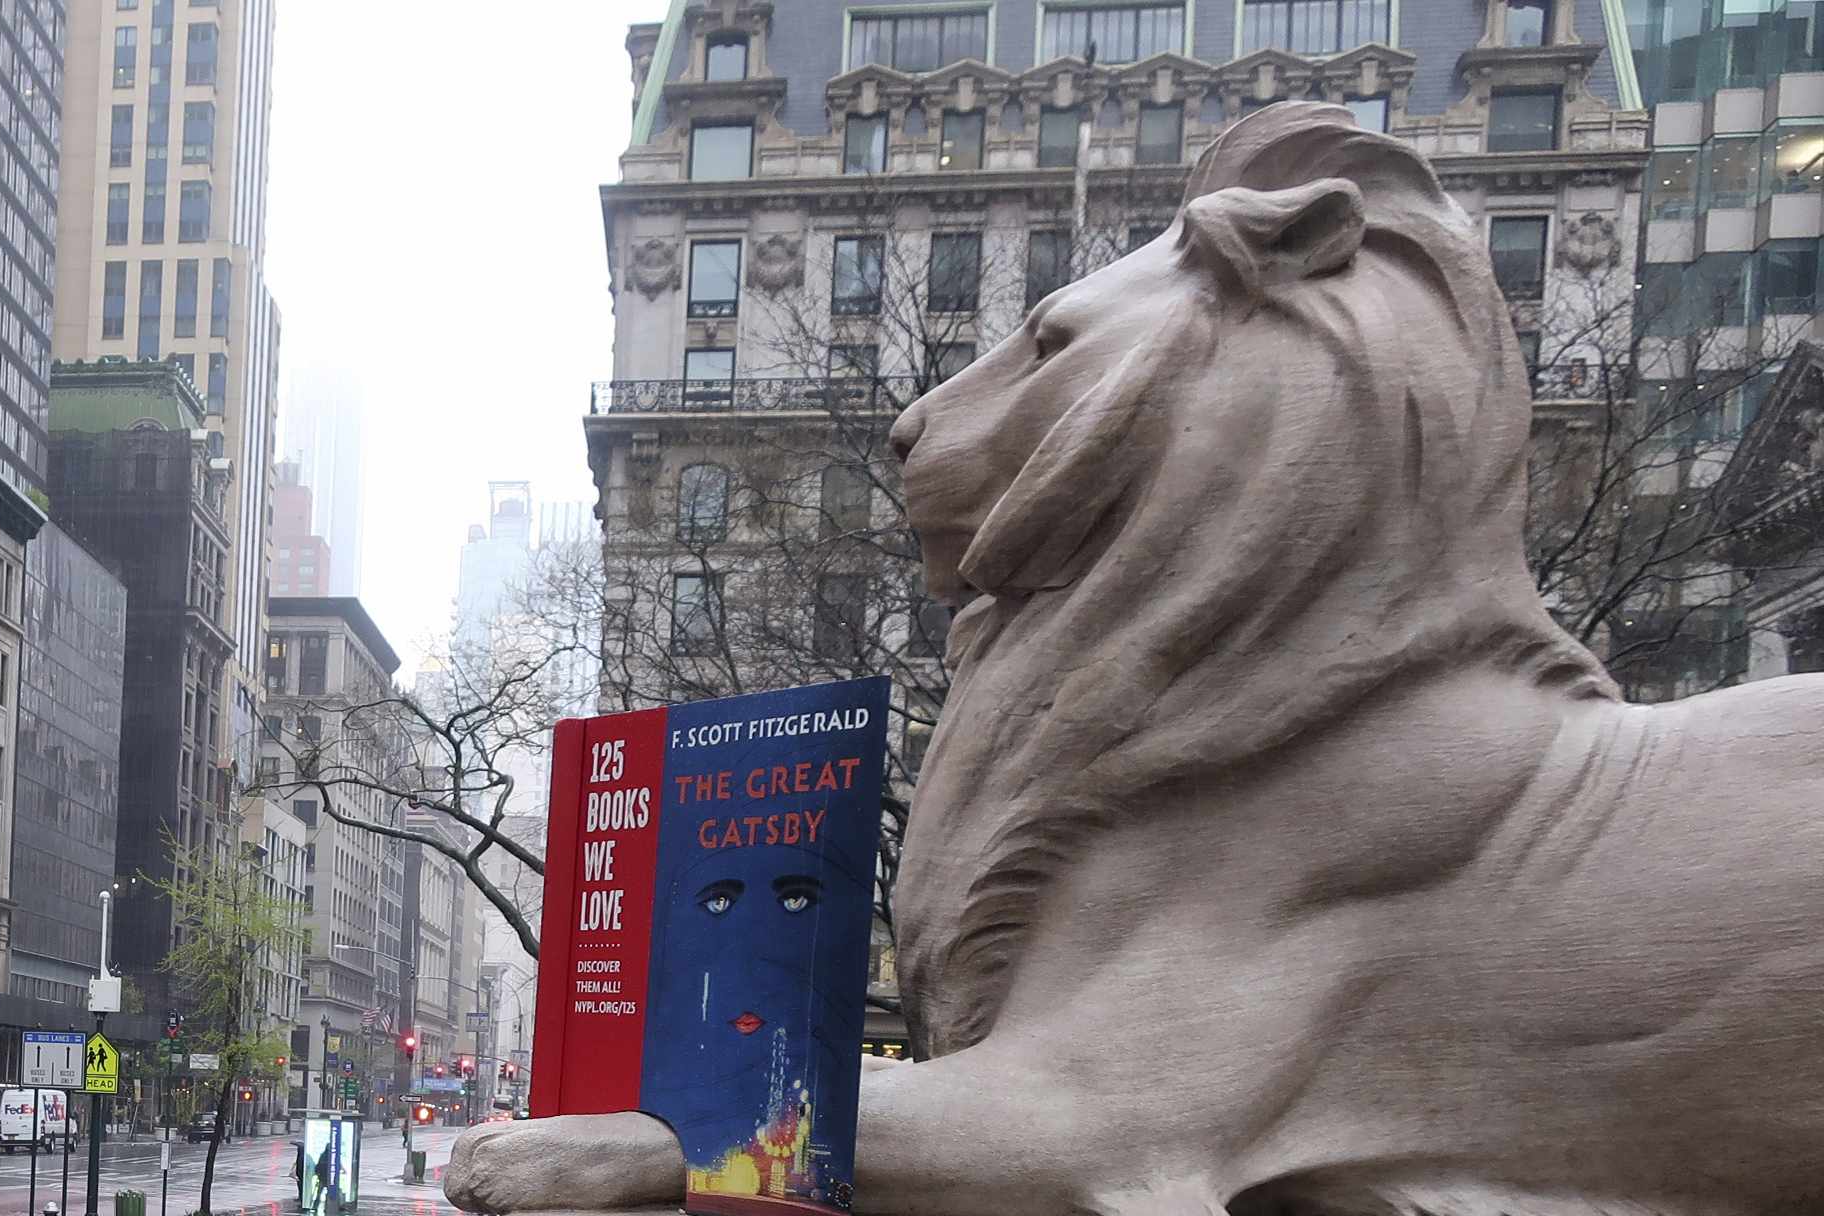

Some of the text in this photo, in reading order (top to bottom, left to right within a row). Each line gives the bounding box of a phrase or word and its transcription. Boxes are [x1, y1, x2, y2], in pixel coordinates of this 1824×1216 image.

[671, 707, 870, 749] F. SCOTT FITZGERALD
[589, 739, 625, 783] 125
[675, 757, 861, 804] THE GREAT
[586, 786, 651, 833] BOOKS
[698, 809, 826, 849] GATSBY
[584, 839, 616, 881] WE
[579, 889, 624, 931] LOVE
[576, 980, 621, 993] THEM ALL!
[577, 960, 621, 973] DISCOVER
[574, 1000, 636, 1016] NYPL.ORG/125
[51, 1034, 70, 1042] LANES
[4, 1103, 35, 1115] FedEx
